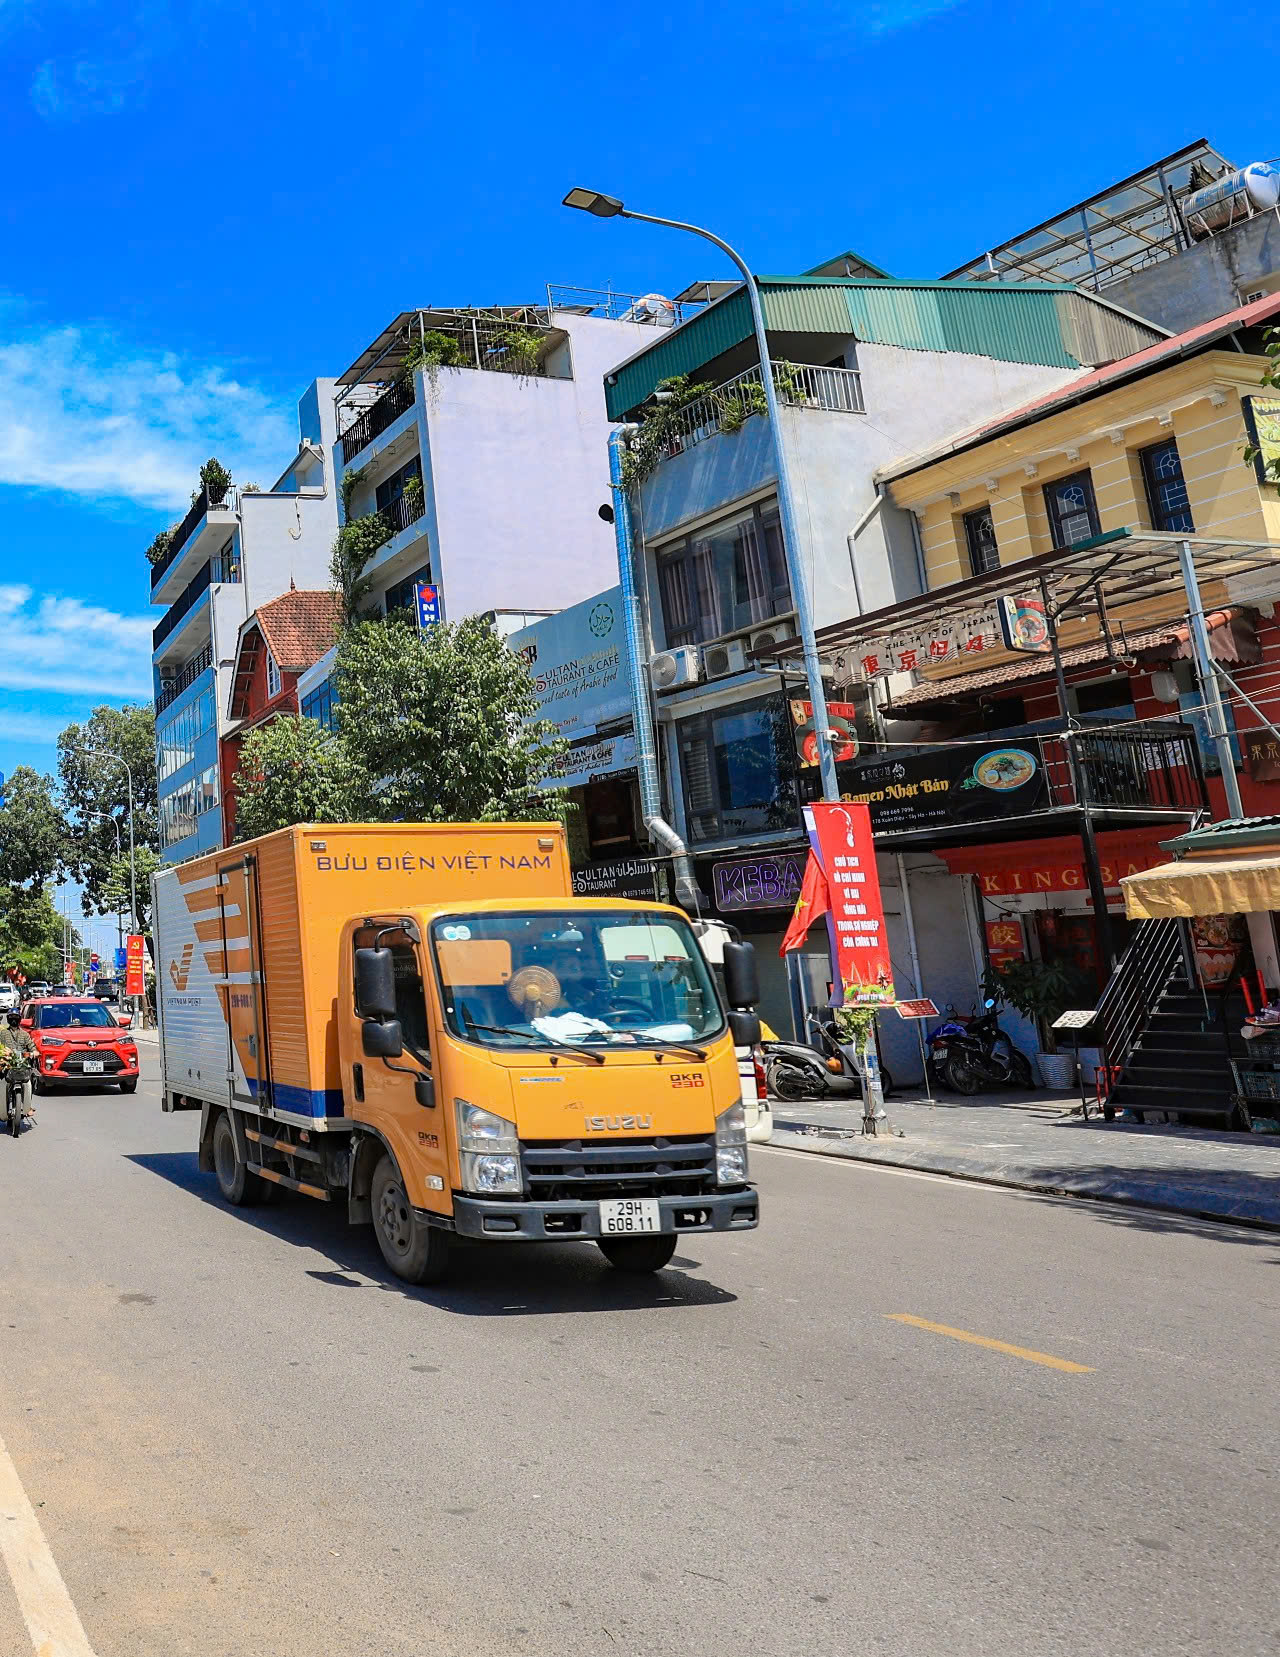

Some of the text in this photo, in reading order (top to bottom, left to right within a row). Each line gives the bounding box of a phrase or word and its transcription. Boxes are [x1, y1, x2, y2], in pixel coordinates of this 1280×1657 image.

[886, 640, 905, 650] THE
[942, 626, 954, 637] OF
[528, 666, 587, 696] ESTAURANT
[841, 778, 950, 802] Ramen Nhật Bản
[317, 850, 551, 875] BƯU ĐIỆN VIỆT NAM
[576, 866, 616, 892] SULTAN
[719, 860, 804, 904] KEBA
[984, 869, 1079, 892] KING
[670, 1073, 703, 1082] QKR
[672, 1081, 705, 1089] 230
[584, 1114, 652, 1131] ISUZU
[418, 1131, 439, 1141] QKR
[419, 1140, 439, 1149] 230
[617, 1202, 643, 1216] 29H
[607, 1217, 653, 1231] 608.11
